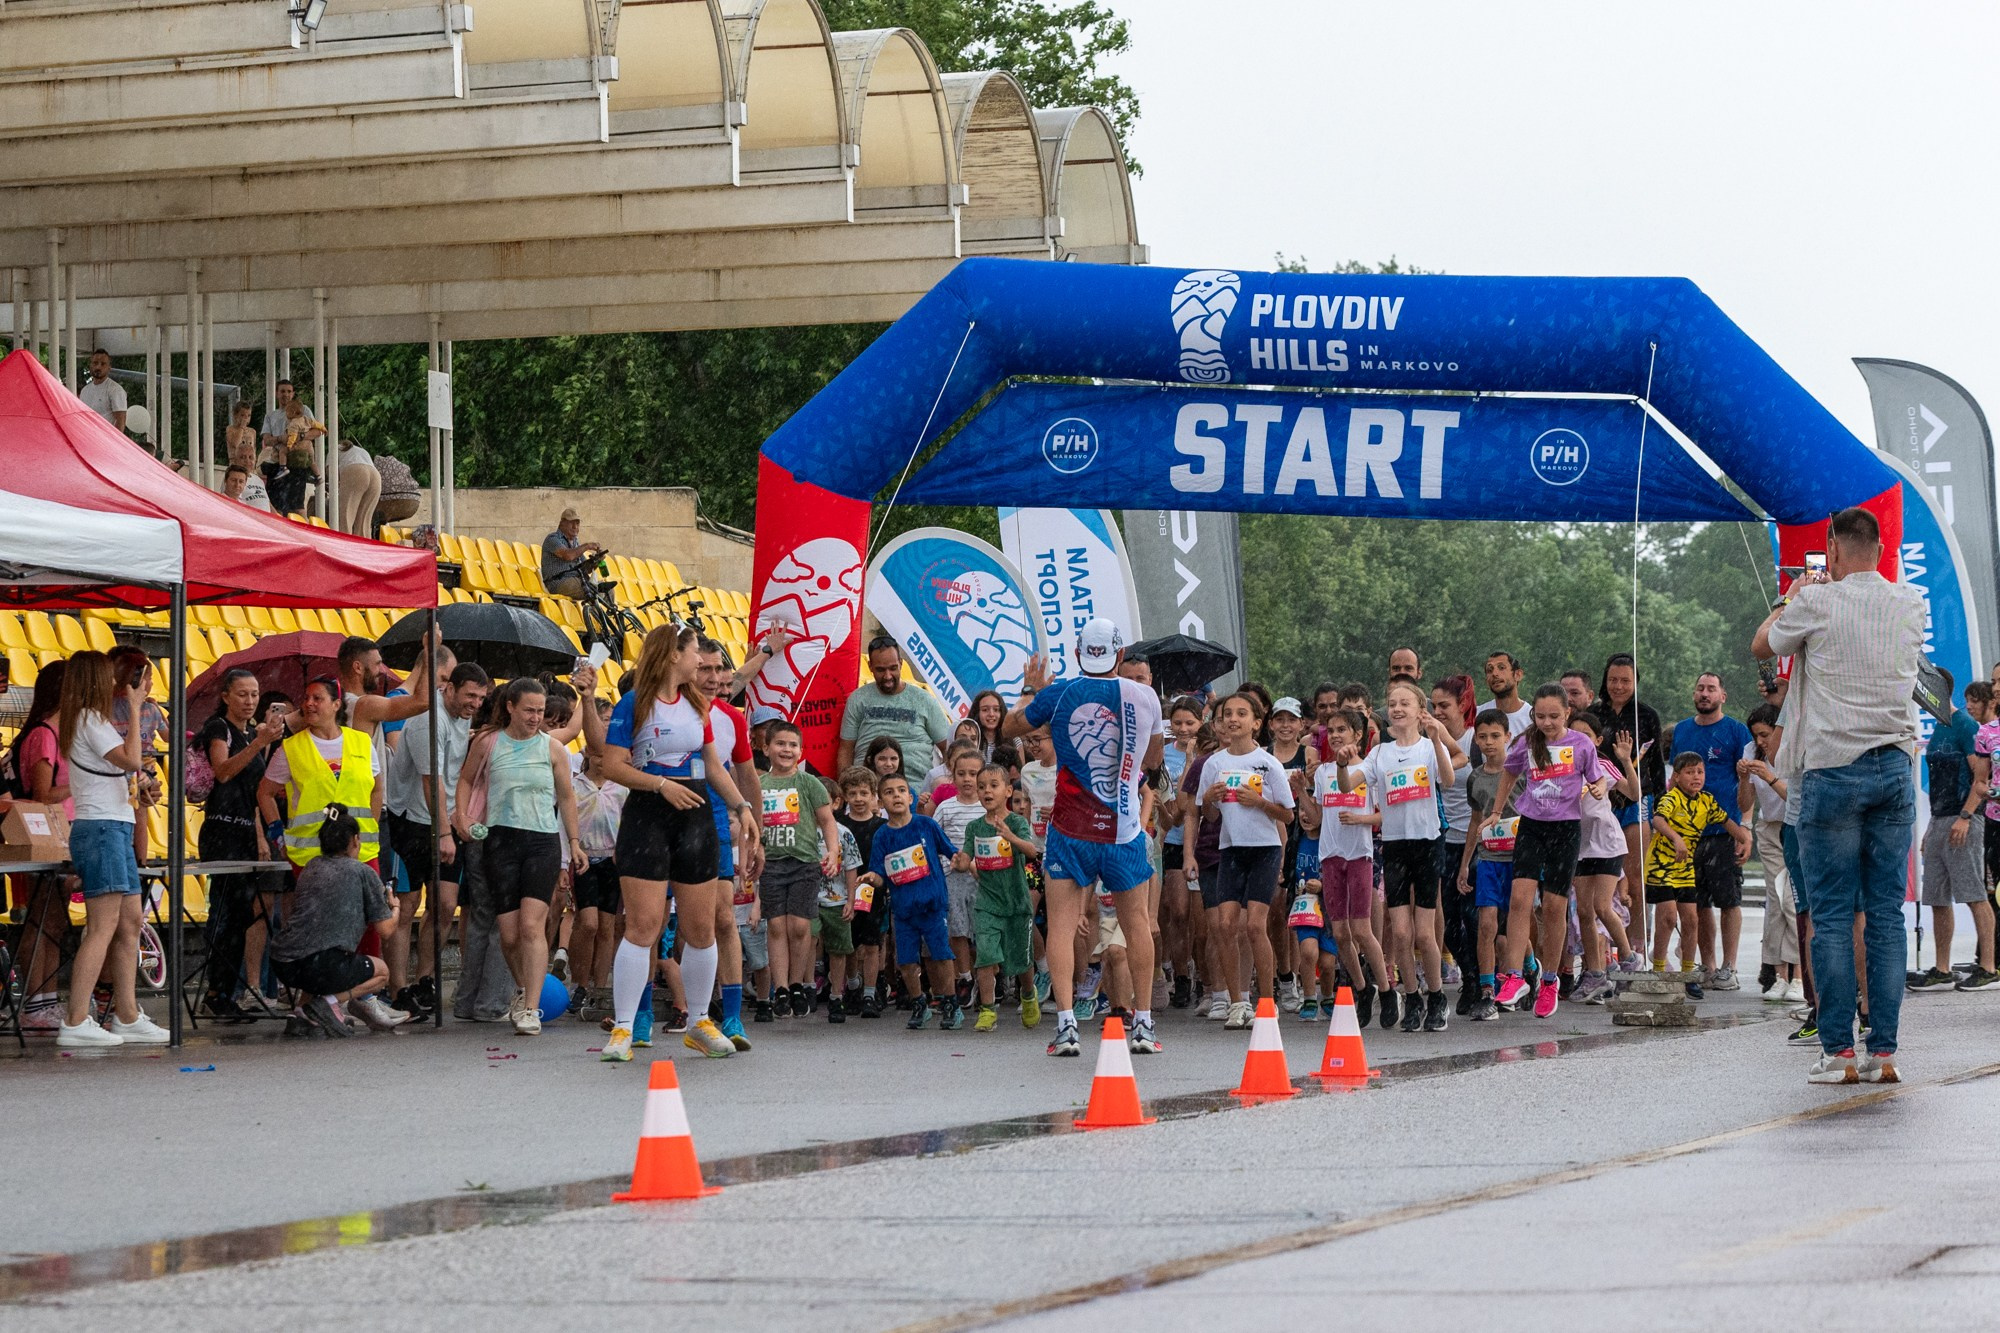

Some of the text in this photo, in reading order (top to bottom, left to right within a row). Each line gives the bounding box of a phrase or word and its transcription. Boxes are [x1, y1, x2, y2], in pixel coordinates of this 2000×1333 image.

[1250, 293, 1405, 331] PLOVDIV
[1250, 337, 1379, 372] HILLS IN
[1360, 361, 1459, 372] MARKOVO
[1052, 435, 1089, 453] P/H
[1169, 402, 1461, 499] START
[1541, 446, 1579, 464] P/H
[790, 697, 837, 713] PLOVDIV
[801, 712, 832, 728] HILLS
[1119, 701, 1136, 816] EVERY STEP MATTERS
[1226, 776, 1241, 787] 47
[1391, 774, 1407, 787] 48
[763, 800, 777, 811] 27
[1490, 826, 1505, 837] 16
[978, 844, 991, 855] 85
[891, 856, 906, 871] 81
[1293, 900, 1308, 912] 39
